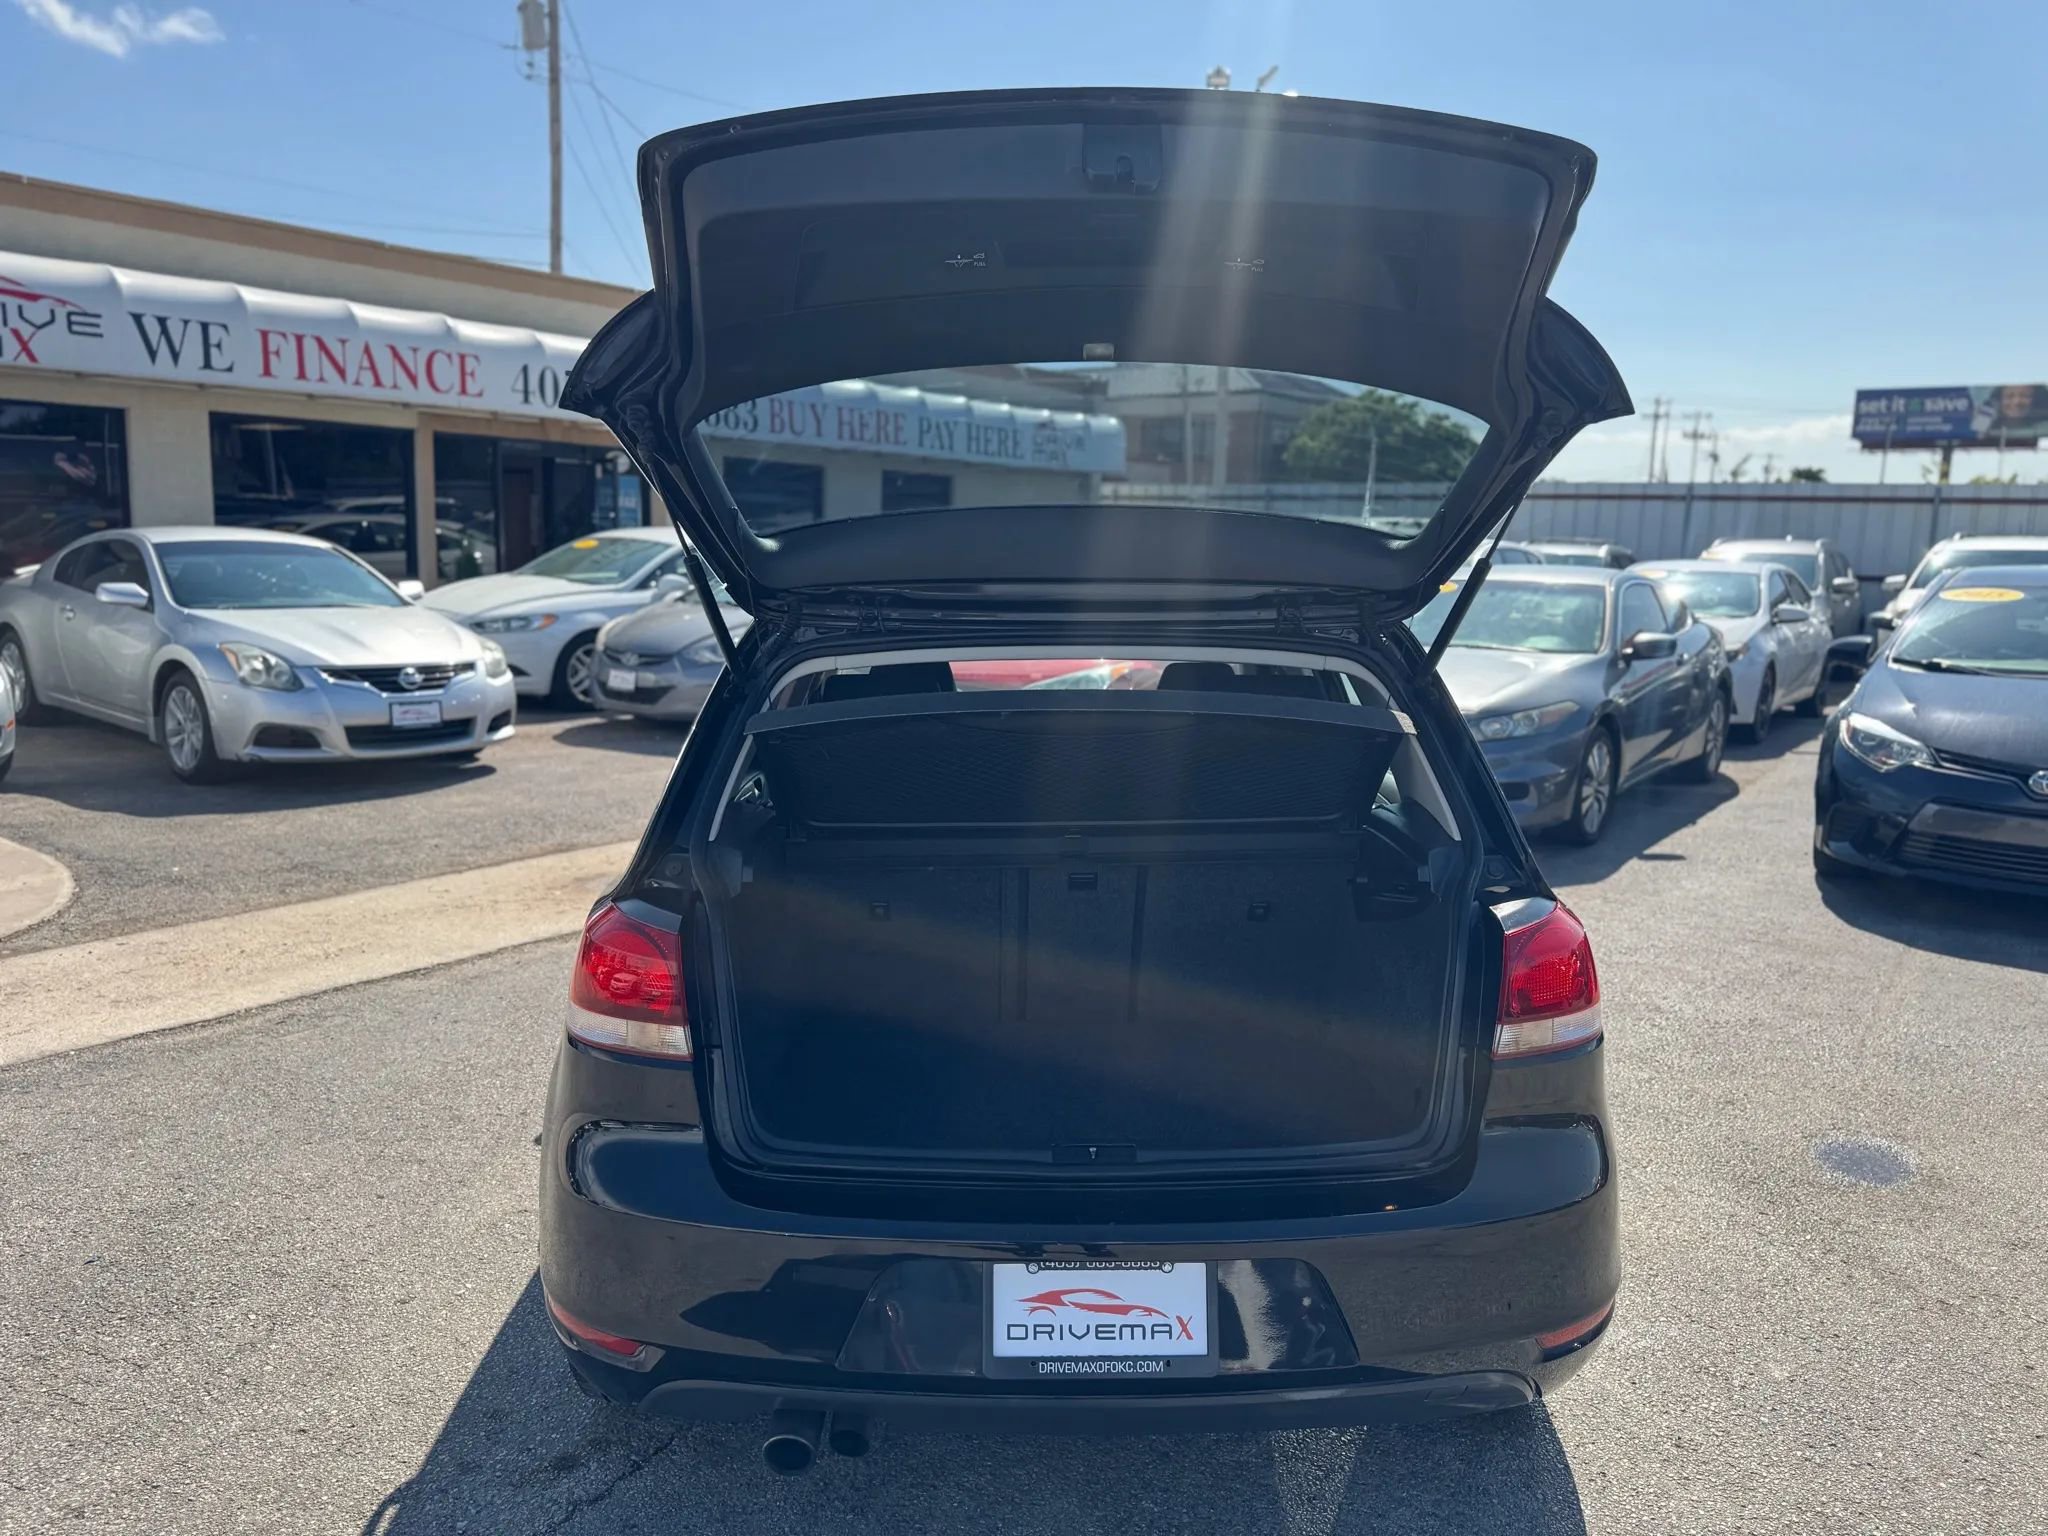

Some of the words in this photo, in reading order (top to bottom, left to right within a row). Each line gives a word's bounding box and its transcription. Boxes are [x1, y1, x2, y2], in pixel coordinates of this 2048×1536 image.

[0, 328, 38, 363] X
[128, 311, 235, 373] WE
[256, 328, 484, 398] FINANCE
[1858, 396, 1888, 415] set
[1891, 394, 1906, 414] it
[1924, 396, 1969, 412] save
[768, 398, 828, 438] BUY
[836, 406, 907, 445] HERE
[917, 416, 960, 451] PAY
[966, 423, 1025, 460] HERE
[1006, 1315, 1194, 1341] DRIVEMAX
[1039, 1360, 1164, 1374] DRIVEMAXOFOKC.COM
